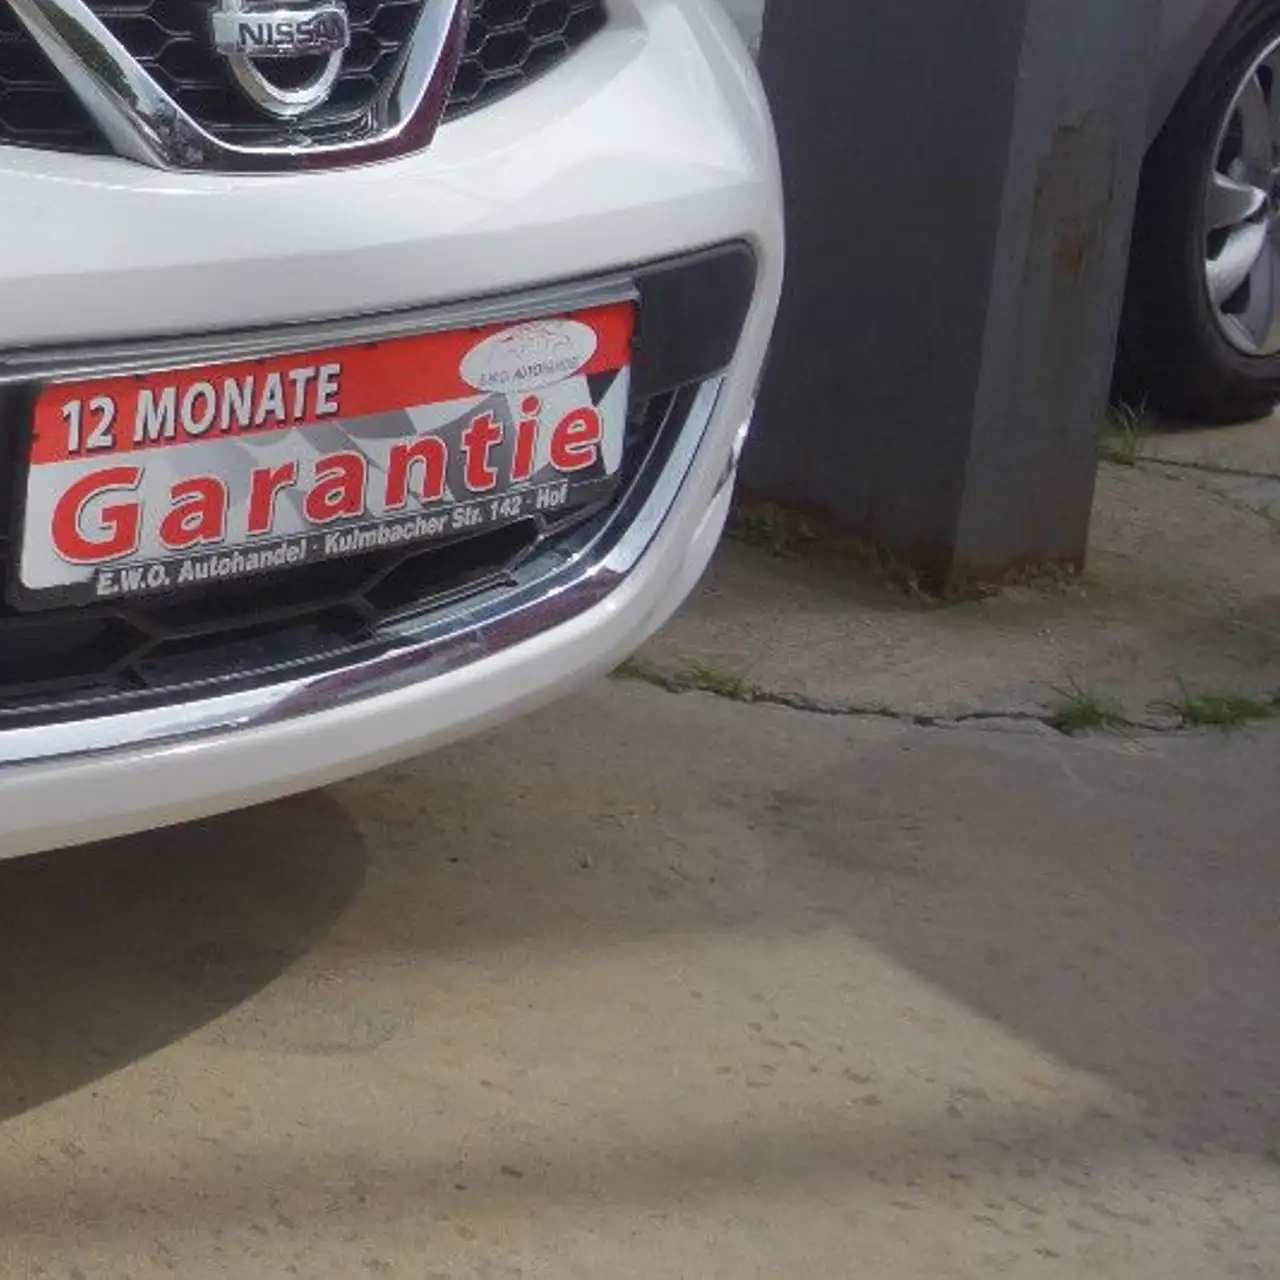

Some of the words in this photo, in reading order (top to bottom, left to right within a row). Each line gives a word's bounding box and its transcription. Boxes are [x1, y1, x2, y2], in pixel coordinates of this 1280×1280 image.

[62, 395, 116, 453] 12
[132, 363, 342, 443] MONATE
[49, 394, 604, 566] Garantie
[95, 564, 170, 597] E.W.O.
[177, 538, 307, 584] Autohandel
[324, 513, 449, 555] Kulmbacher
[451, 505, 483, 529] Str.
[489, 495, 522, 520] 142
[535, 483, 569, 509] Hof
